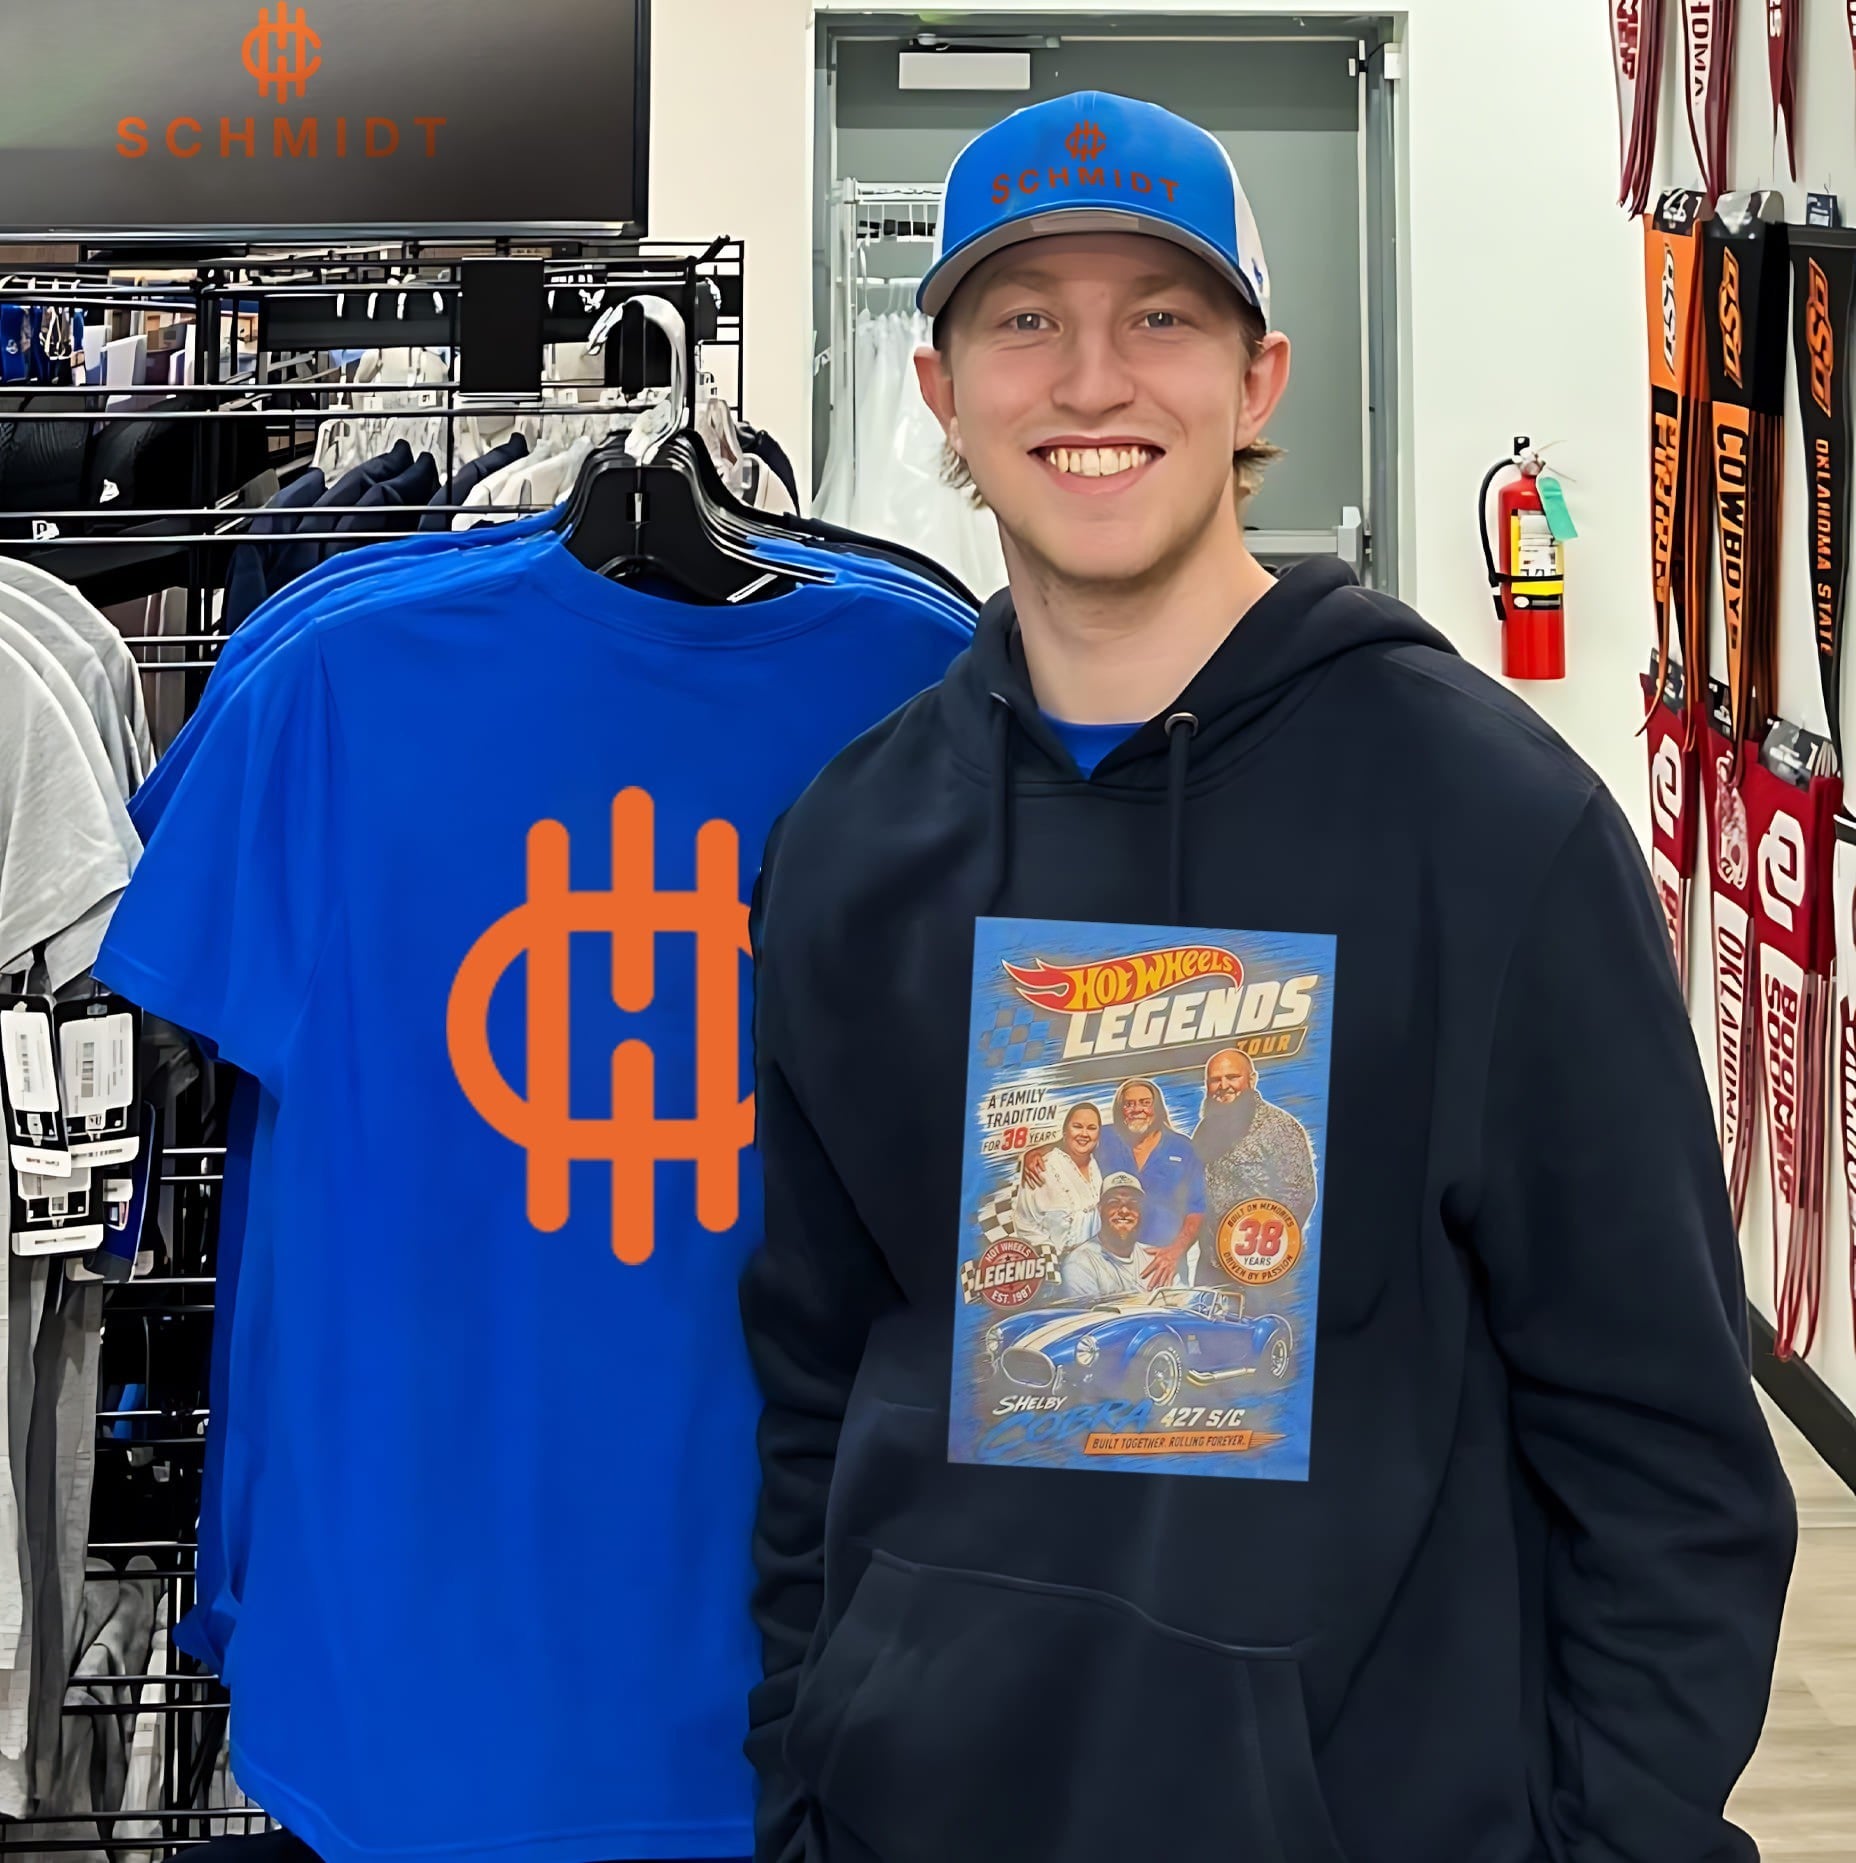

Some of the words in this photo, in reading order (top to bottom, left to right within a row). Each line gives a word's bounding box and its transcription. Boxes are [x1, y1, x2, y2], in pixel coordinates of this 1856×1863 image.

[115, 116, 448, 159] SCHMIDT
[990, 167, 1181, 205] SCHMIDT
[1815, 438, 1832, 571] OKLAHOMA
[1063, 974, 1319, 1059] LEGENDS
[1236, 1033, 1292, 1057] TOUR
[1718, 925, 1746, 1145] OKLAHOMA
[988, 1094, 996, 1110] A
[1000, 1088, 1047, 1107] FAMILY
[987, 1105, 1057, 1128] TRADITION
[983, 1140, 1000, 1152] FOR
[1001, 1126, 1029, 1151] 38
[1029, 1131, 1057, 1143] YEARS
[1227, 1208, 1245, 1228] BUILT
[1246, 1203, 1258, 1213] ON
[1260, 1202, 1295, 1228] MEMORIES
[1234, 1218, 1284, 1257] 38
[985, 1247, 1000, 1262] HOT
[1000, 1241, 1032, 1258] WHEELS
[1243, 1257, 1272, 1267] YEARS
[974, 1257, 1046, 1292] LEGENDS
[1223, 1251, 1246, 1278] DRIVEN
[1247, 1272, 1259, 1280] BY
[1261, 1254, 1294, 1281] PASSION
[991, 1290, 1010, 1304] EST.
[1012, 1284, 1033, 1304] 1987
[992, 1395, 1068, 1416] SHELBY
[1161, 1407, 1208, 1428] 427
[1205, 1408, 1246, 1428] S/C
[978, 1399, 1155, 1458] COBRA
[1092, 1438, 1120, 1449] BUILT
[1168, 1436, 1206, 1448] ROLLING
